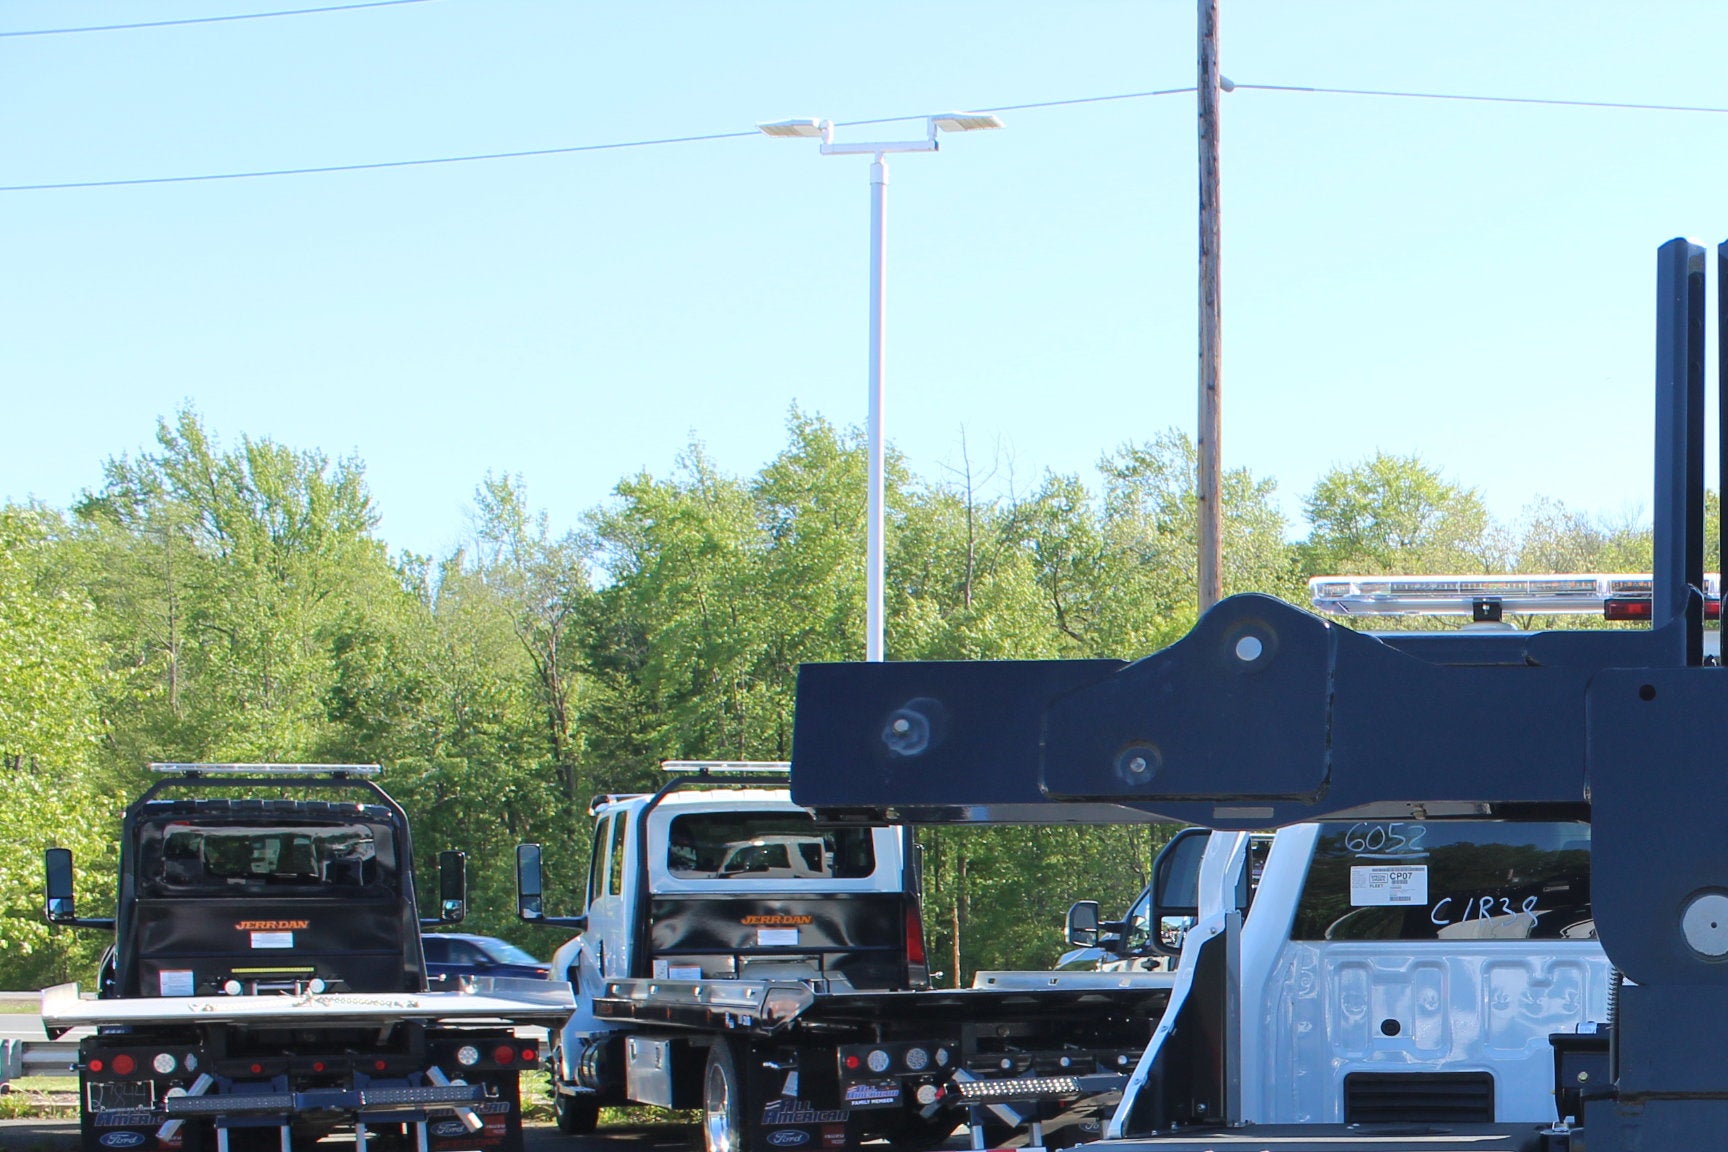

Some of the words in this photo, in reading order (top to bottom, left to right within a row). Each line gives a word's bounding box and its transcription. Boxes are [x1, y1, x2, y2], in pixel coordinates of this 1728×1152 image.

[1345, 822, 1427, 853] 6052
[1389, 872, 1413, 880] CP07
[235, 920, 310, 930] JERR-DAN
[740, 914, 814, 925] JERR-DAN
[780, 1098, 814, 1112] ALL
[761, 1110, 851, 1125] AMERICAN
[106, 1134, 138, 1145] Ford
[773, 1133, 803, 1143] Ford
